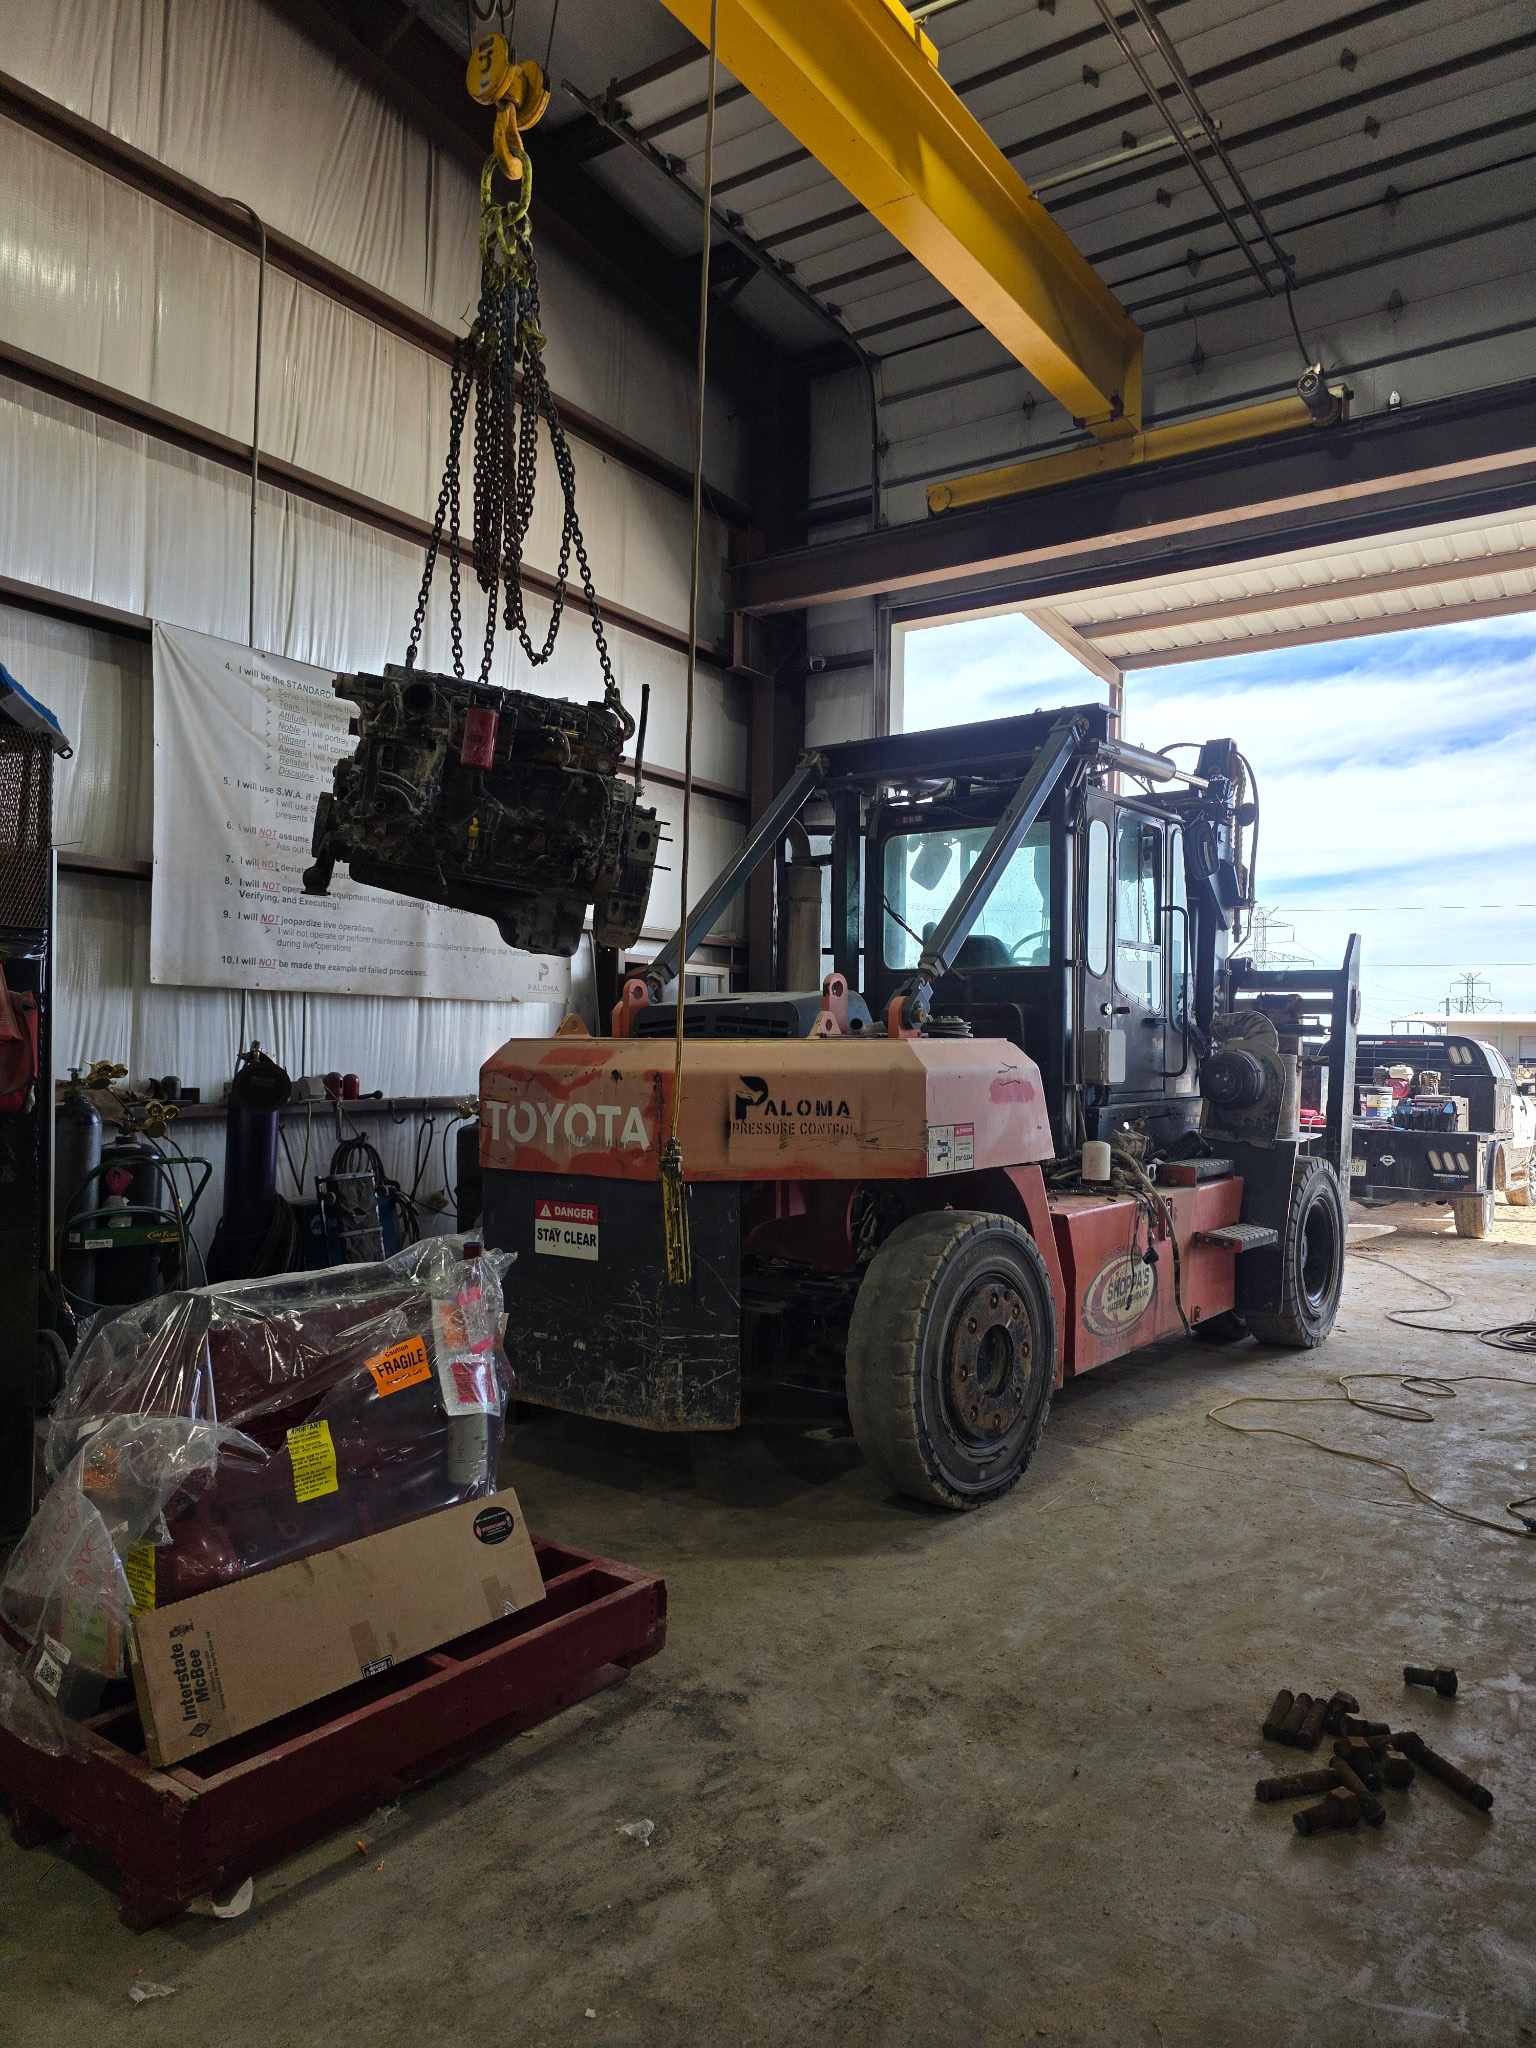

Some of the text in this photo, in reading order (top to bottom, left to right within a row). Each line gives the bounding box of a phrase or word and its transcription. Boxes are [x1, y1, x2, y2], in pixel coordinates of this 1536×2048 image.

[225, 662, 233, 672] 4.
[244, 668, 259, 678] will
[261, 671, 271, 681] be
[273, 676, 285, 686] the
[286, 680, 335, 700] STANDARD!
[278, 689, 299, 701] Serve
[310, 697, 321, 706] will
[324, 701, 342, 712] serve
[280, 701, 299, 712] Team
[311, 709, 322, 718] will
[279, 711, 307, 725] Attitude
[319, 722, 329, 730] will
[331, 724, 340, 733] be
[278, 722, 300, 734] Noble
[312, 731, 323, 739] will
[325, 734, 349, 747] portray
[278, 732, 306, 746] Diligent
[317, 743, 329, 752] will
[279, 744, 303, 756] Aware
[314, 754, 326, 762] will
[278, 766, 314, 780] Discipline
[279, 755, 309, 769] Reliable
[320, 765, 332, 773] will
[223, 776, 231, 786] 5.
[242, 782, 257, 790] will
[260, 785, 274, 794] use
[276, 787, 303, 800] S.W.A.
[305, 792, 311, 801] if
[275, 811, 308, 823] presents
[280, 801, 293, 809] will
[295, 803, 309, 812] use
[226, 820, 234, 830] 6.
[243, 826, 257, 834] will
[259, 828, 278, 838] NOT
[279, 832, 309, 844] assume
[276, 842, 290, 851] Ass
[292, 845, 305, 854] out
[225, 854, 234, 864] 7.
[245, 859, 259, 867] will
[262, 860, 279, 870] NOT
[281, 864, 304, 874] deviat
[224, 876, 233, 885] 8.
[245, 880, 259, 888] will
[262, 881, 280, 891] NOT
[332, 892, 370, 902] equipment
[371, 897, 395, 906] without
[396, 900, 424, 910] utilizing
[239, 890, 342, 911] Verifying, and Executing).
[223, 910, 231, 919] 9.
[243, 913, 258, 921] will
[260, 914, 280, 923] NOT
[281, 916, 322, 928] jeopardize
[323, 920, 337, 929] live
[339, 924, 376, 934] operations.
[276, 939, 352, 953] during live operations
[283, 928, 295, 937] will
[296, 930, 308, 938] not
[310, 931, 337, 941] operate
[346, 935, 370, 944] perform
[372, 937, 414, 948] maintenance
[472, 946, 496, 956] anything
[497, 948, 508, 956] that
[241, 957, 256, 965] will
[259, 958, 277, 968] NOT
[279, 960, 288, 968] be
[291, 962, 312, 970] made
[314, 962, 326, 971] the
[328, 964, 357, 974] example
[368, 966, 387, 975] failed
[389, 969, 428, 978] processes.
[528, 984, 559, 993] PALOMA
[735, 1074, 850, 1120] PALOMA
[484, 1101, 651, 1151] TOYOTA
[732, 1122, 796, 1135] PRESSURE
[554, 1206, 594, 1220] DANGER
[537, 1227, 597, 1247] STAY CLEAR
[384, 1344, 409, 1358] Caution
[375, 1348, 424, 1378] FRAGILE
[170, 1643, 197, 1721] Interstate
[190, 1649, 210, 1703] McBee
